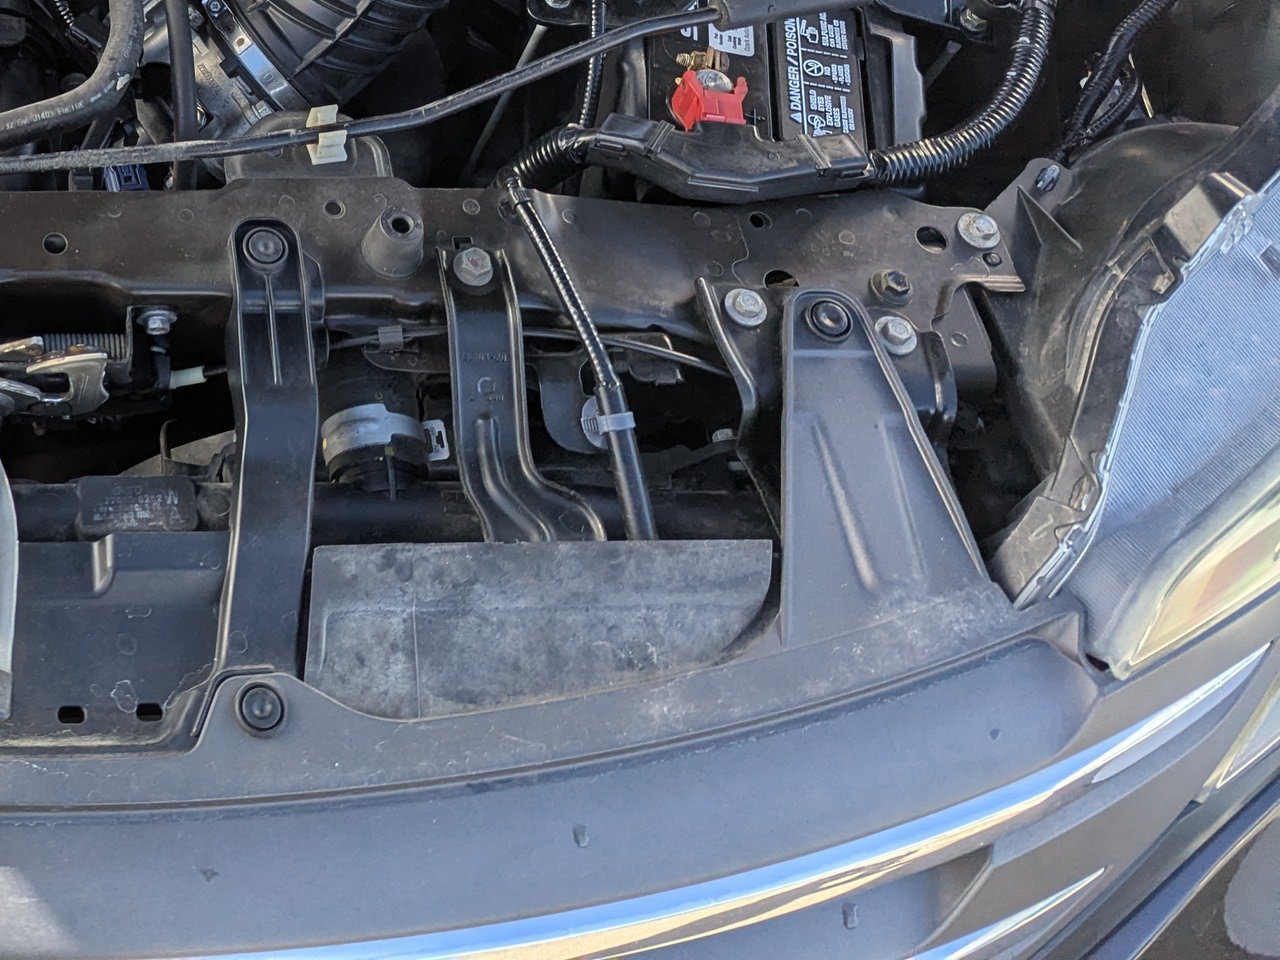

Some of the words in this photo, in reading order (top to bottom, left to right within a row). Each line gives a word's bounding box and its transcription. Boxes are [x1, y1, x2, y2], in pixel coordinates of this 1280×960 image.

[785, 18, 798, 56] POISON
[789, 65, 802, 110] DANGER
[825, 66, 831, 75] NO
[825, 95, 833, 126] EXPLOSIVE
